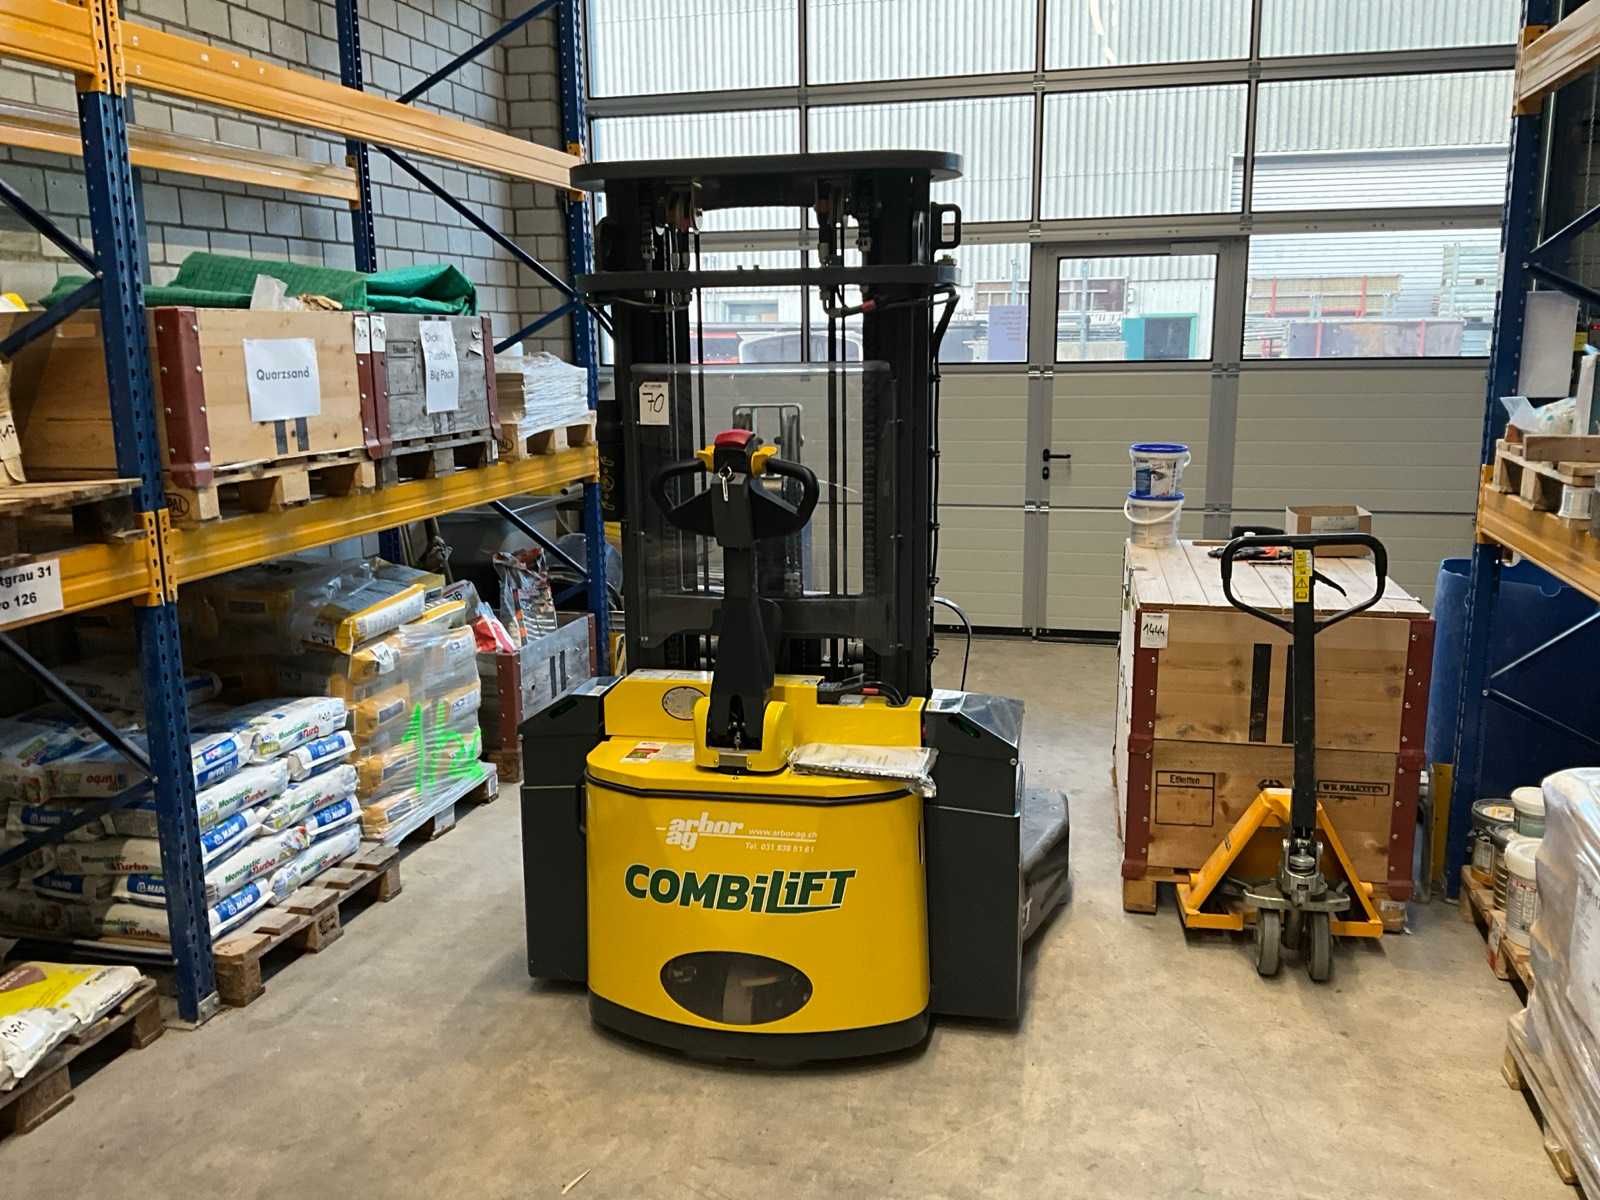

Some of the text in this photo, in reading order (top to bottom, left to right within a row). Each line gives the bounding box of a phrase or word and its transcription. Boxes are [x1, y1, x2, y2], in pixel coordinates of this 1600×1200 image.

[256, 366, 311, 382] Quarzsand
[642, 392, 665, 413] 70
[37, 564, 52, 579] 31
[13, 591, 38, 608] 126
[1143, 623, 1165, 637] 1444
[302, 725, 321, 738] Turb
[668, 812, 745, 835] arbor
[665, 830, 699, 850] ag
